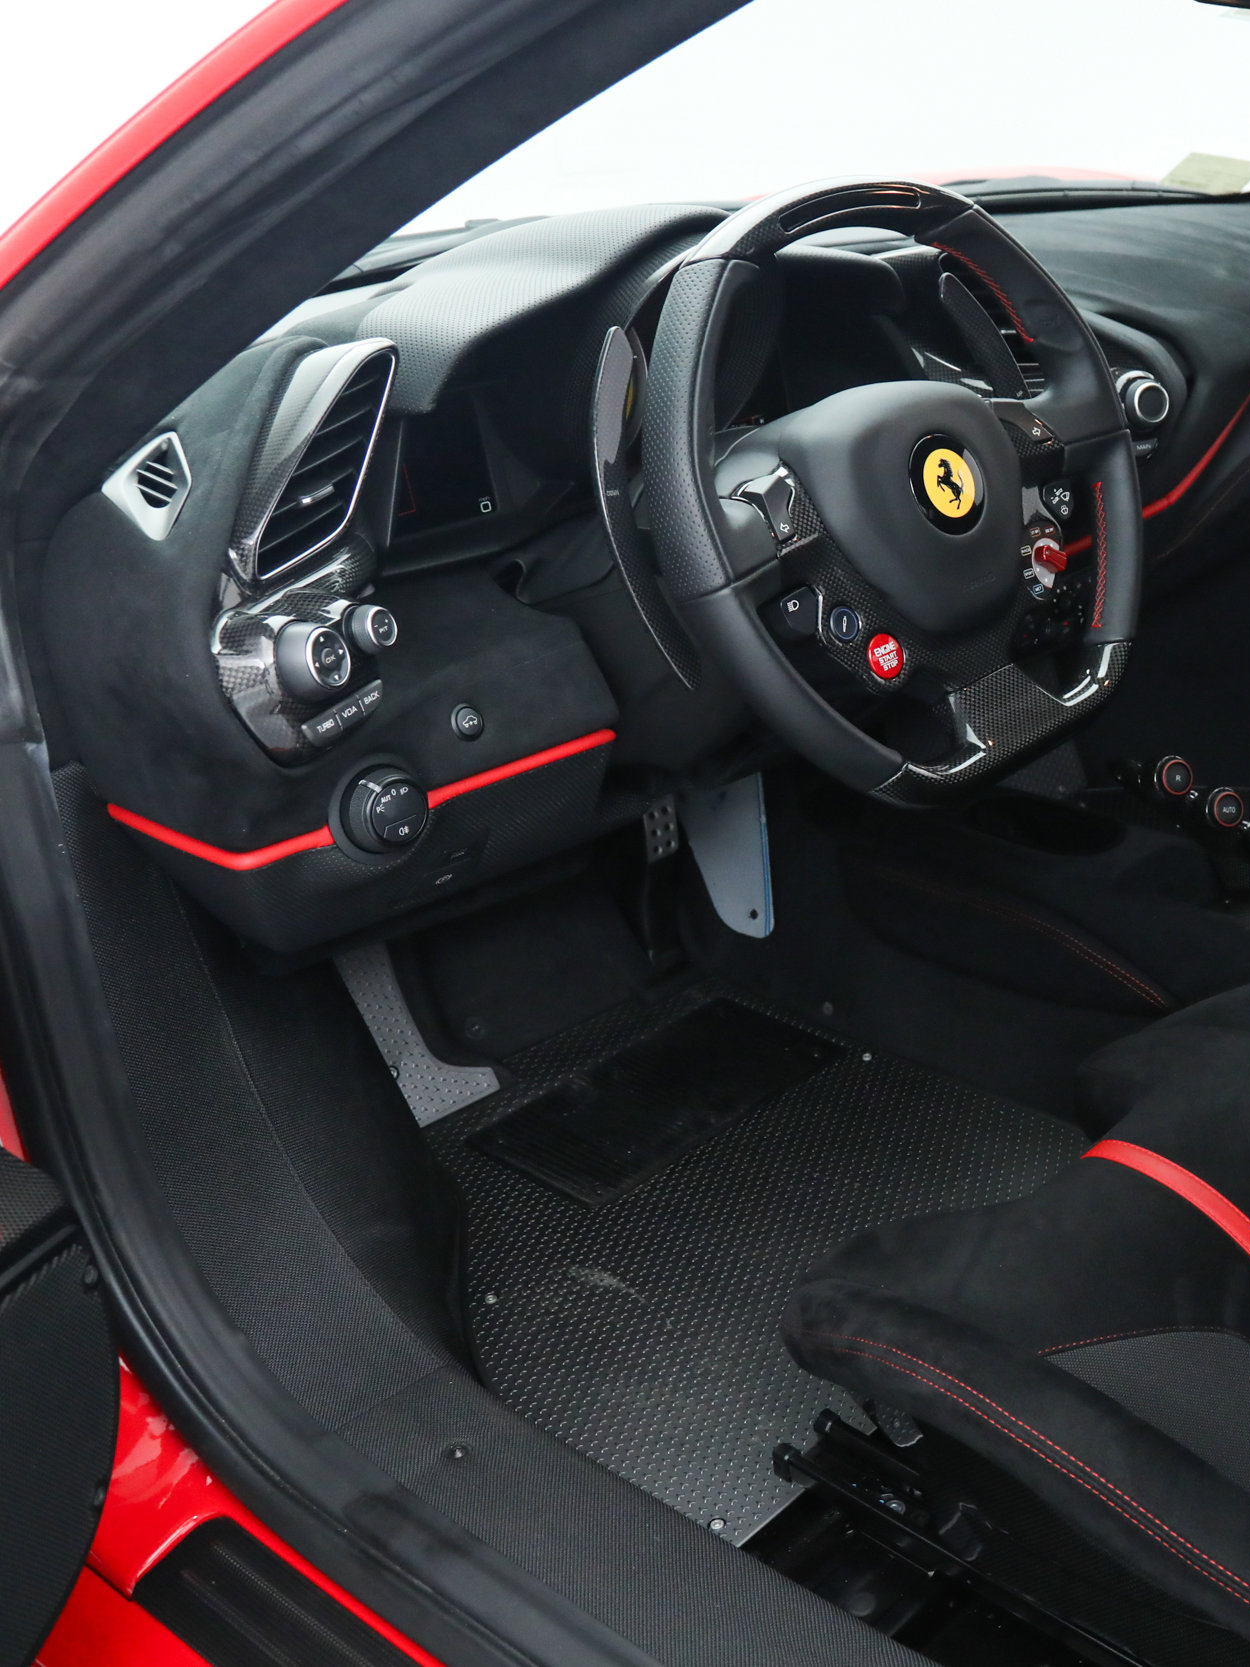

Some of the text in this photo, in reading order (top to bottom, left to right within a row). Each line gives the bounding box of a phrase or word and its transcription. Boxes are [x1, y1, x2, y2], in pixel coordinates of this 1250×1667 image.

[873, 641, 897, 658] ENGINE
[325, 653, 336, 664] OK
[878, 650, 898, 664] START
[882, 659, 899, 671] STOP
[363, 690, 380, 705] BACK
[341, 705, 359, 718] VDA
[317, 719, 335, 734] TURBO
[1175, 774, 1182, 782] R
[1222, 806, 1236, 814] AUTO
